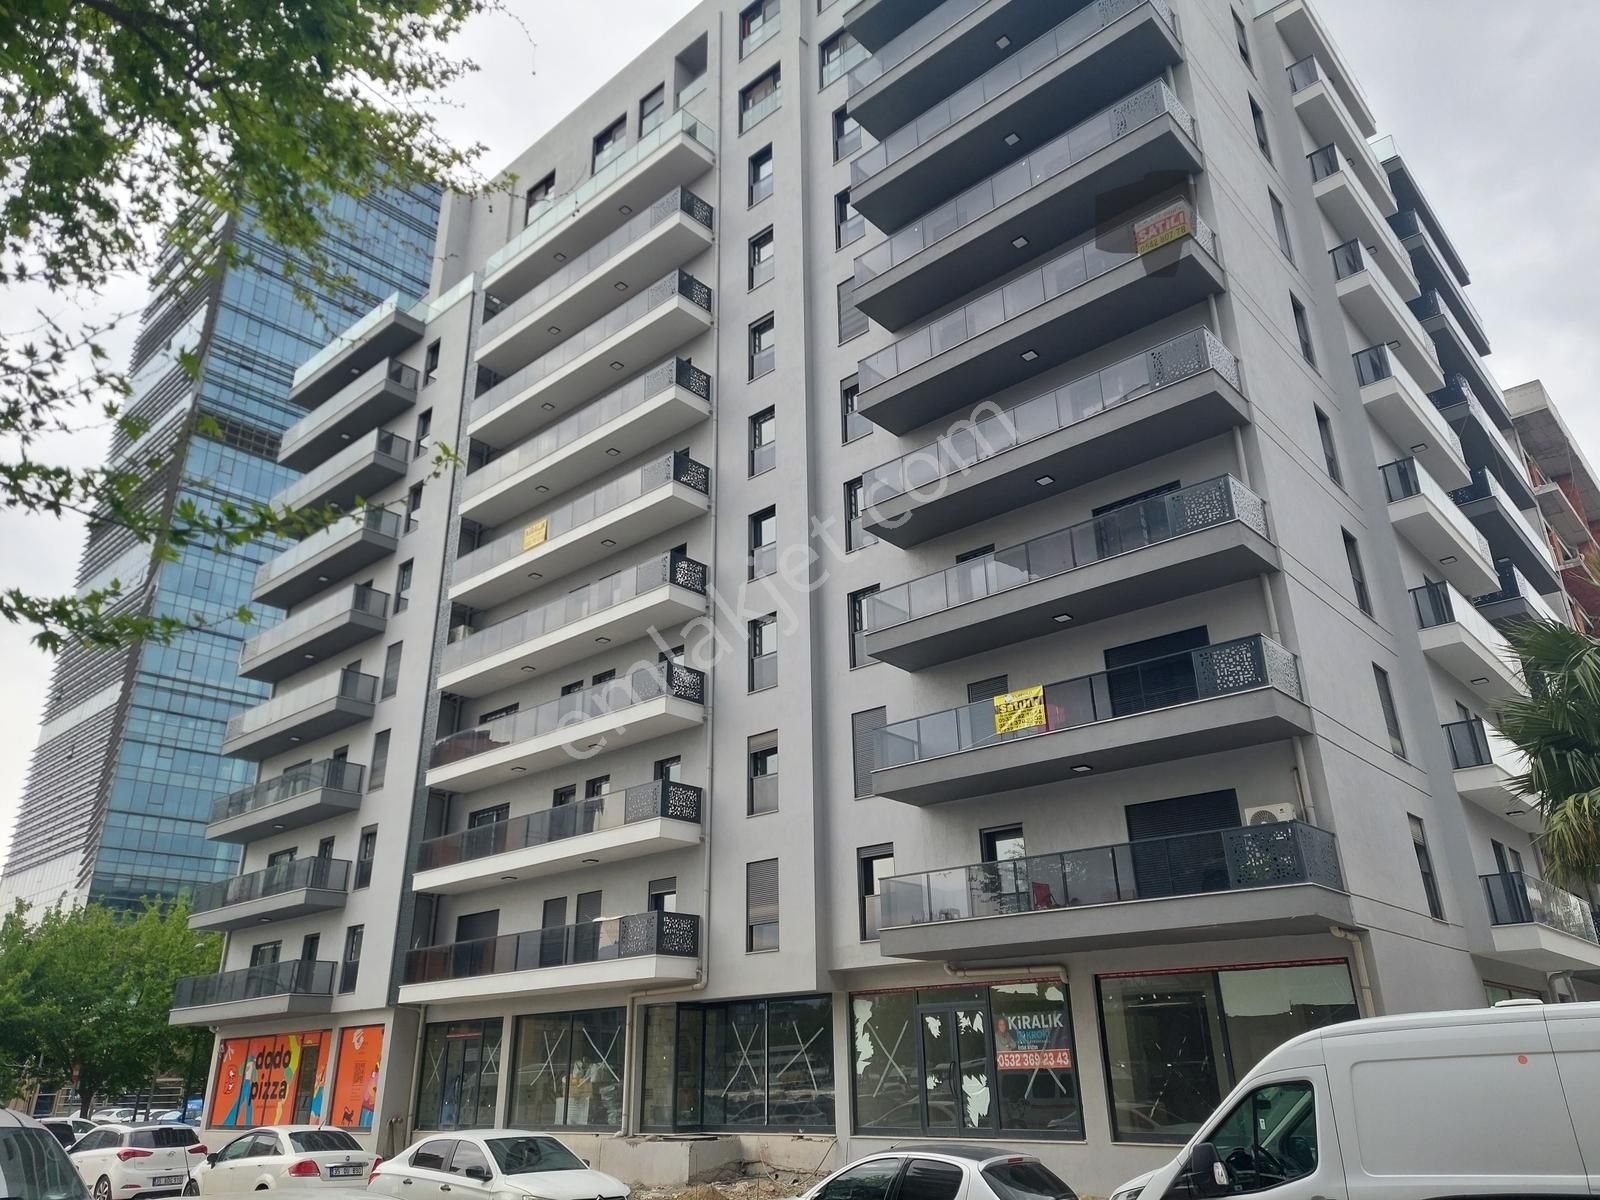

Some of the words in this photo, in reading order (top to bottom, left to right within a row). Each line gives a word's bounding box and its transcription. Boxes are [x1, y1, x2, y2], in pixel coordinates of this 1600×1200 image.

[255, 1044, 291, 1070] dodo
[998, 1053, 1021, 1067] 0532
[1023, 1053, 1040, 1066] 369
[1042, 1052, 1055, 1065] 23
[1056, 1052, 1069, 1065] 43
[249, 1073, 288, 1105] pizza
